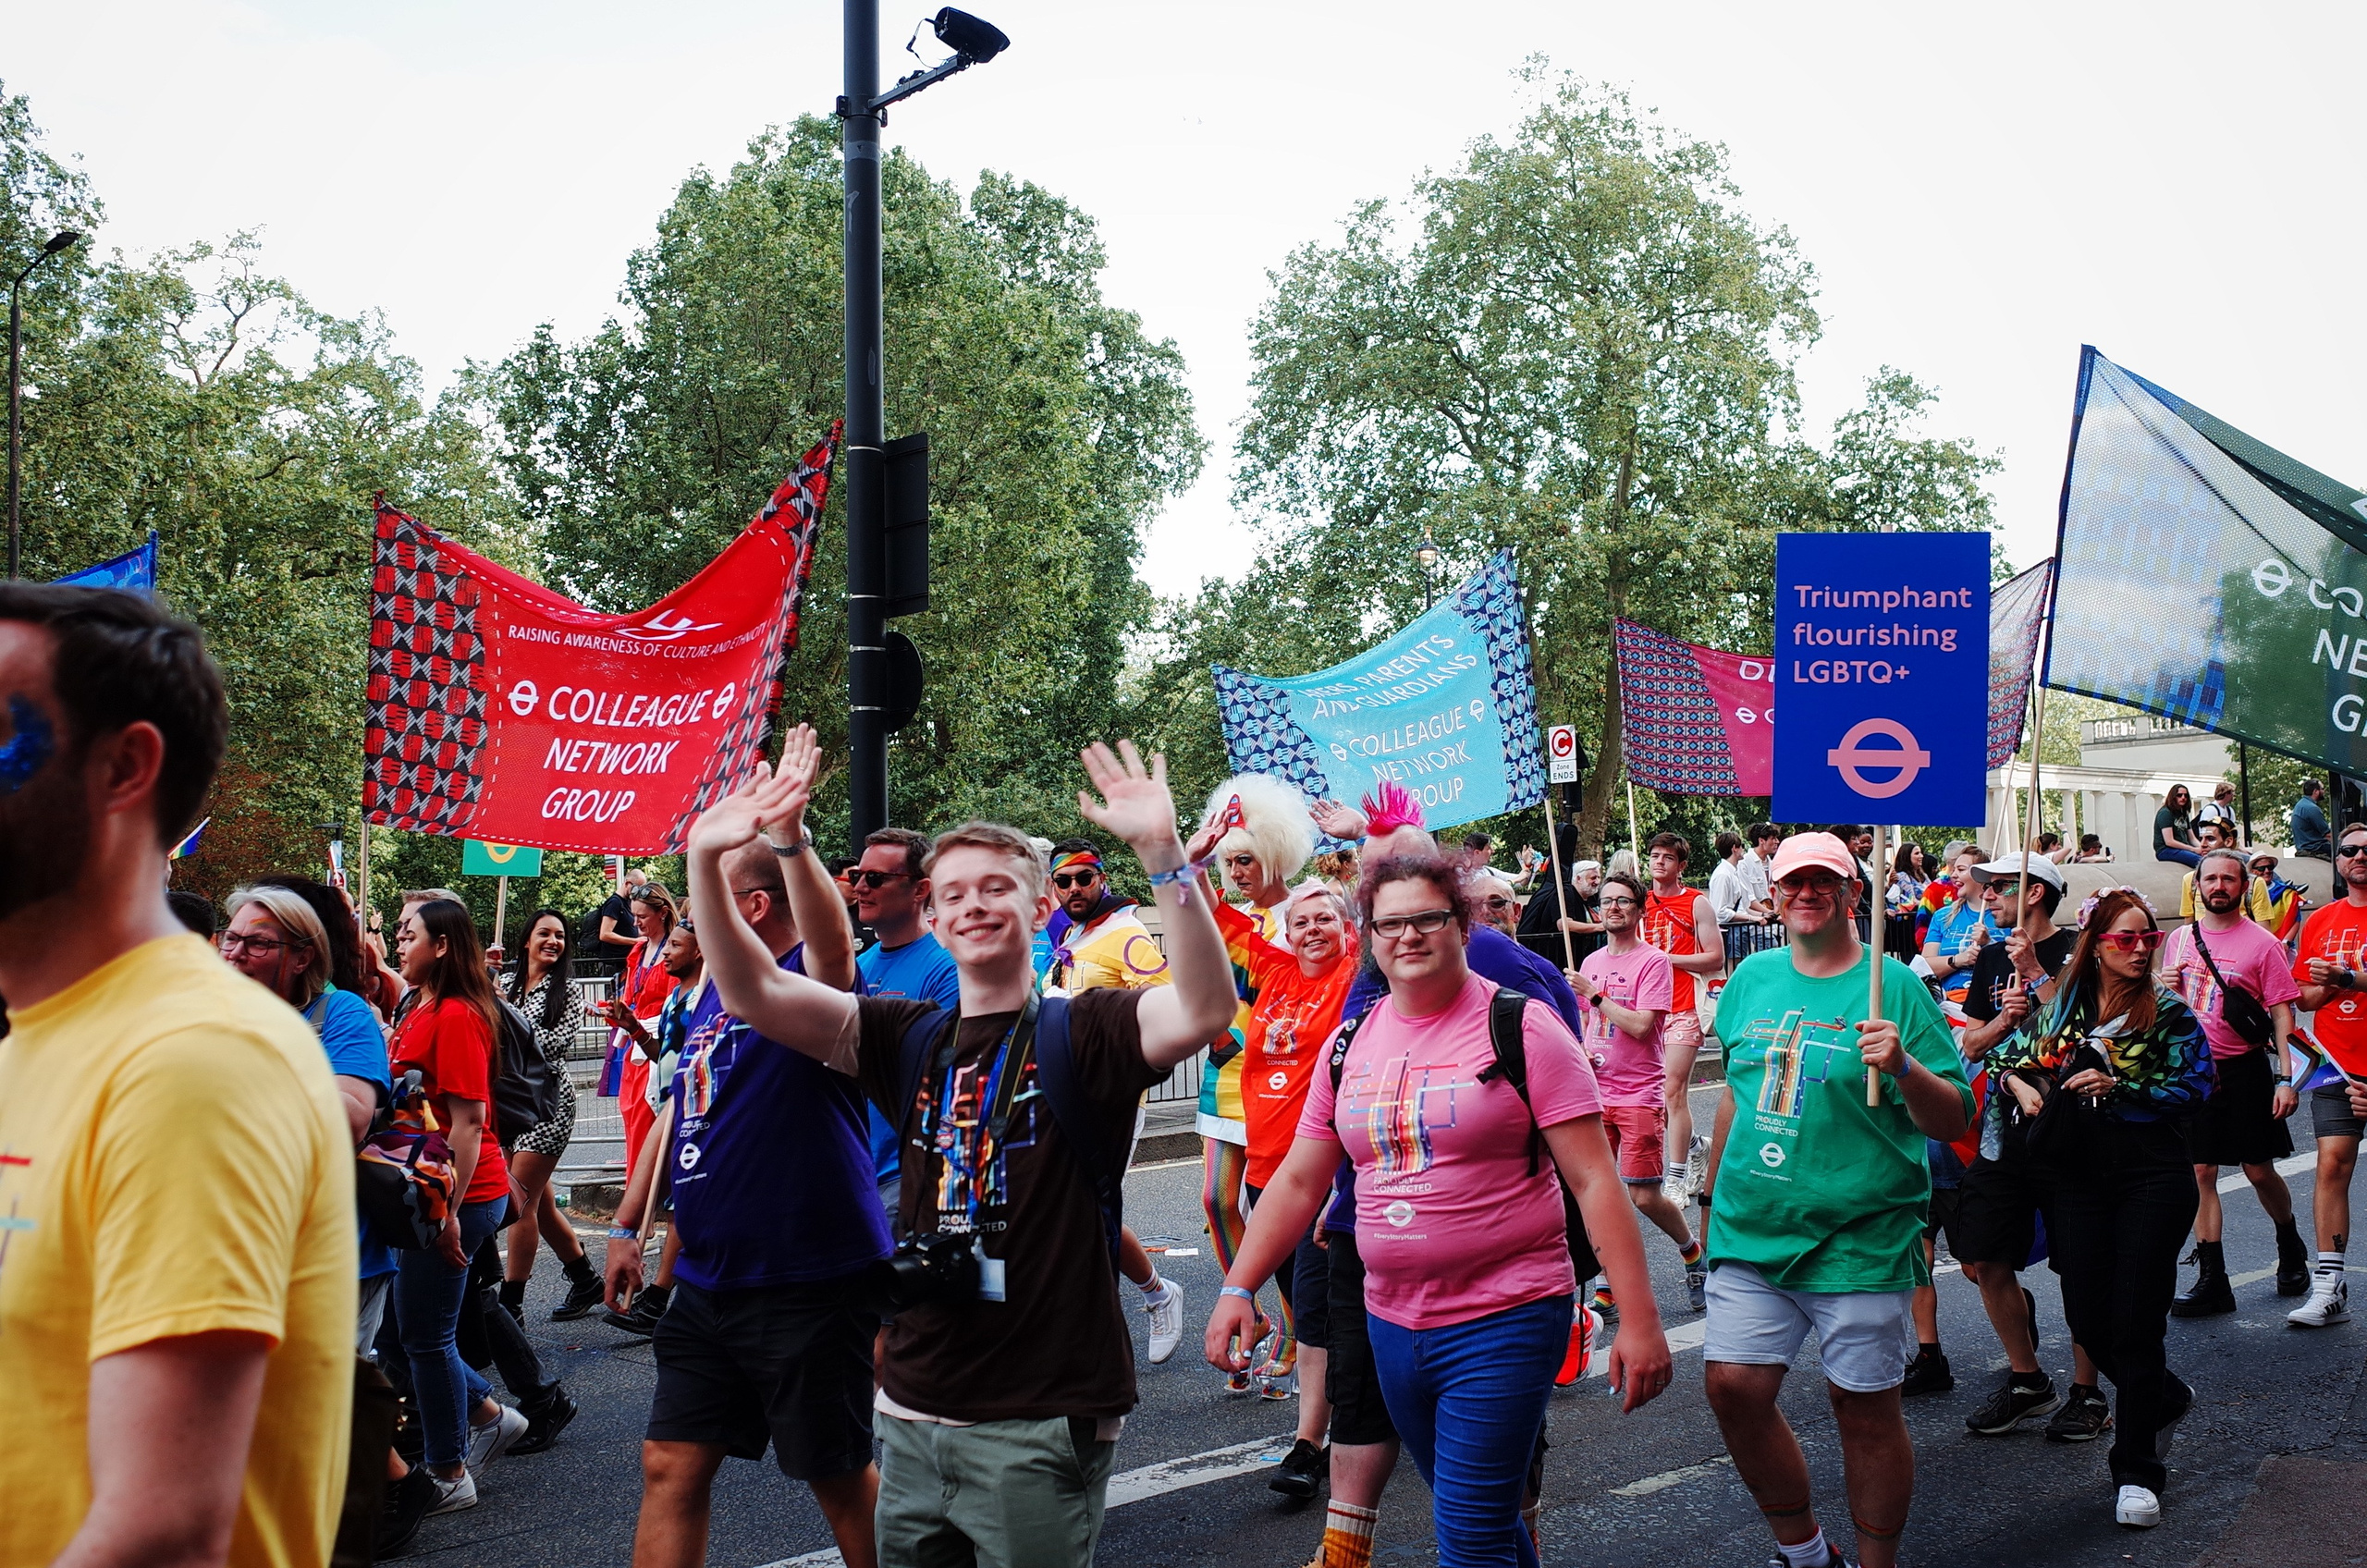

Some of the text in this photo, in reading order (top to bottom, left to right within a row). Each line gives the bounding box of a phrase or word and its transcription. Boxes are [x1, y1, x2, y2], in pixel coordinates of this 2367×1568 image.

[1793, 584, 1972, 614] Triumphant
[508, 624, 561, 645] RAISING
[563, 632, 640, 655] AWARENESS
[643, 643, 663, 657] OF
[663, 644, 713, 659] CULTURE
[711, 639, 732, 655] AND
[1792, 621, 1958, 652] flourishing
[1354, 633, 1455, 688] PARENTS
[1793, 660, 1911, 685] LGBTQ+
[1355, 653, 1478, 707] GUARDIANS
[548, 686, 713, 729] COLLEAGUE
[2332, 693, 2367, 739] G
[1348, 705, 1467, 758] COLLEAGUE
[543, 738, 680, 777] NETWORK
[1371, 740, 1473, 782] NETWORK
[1553, 770, 1575, 780] ENDS
[541, 786, 636, 825] GROUP
[1410, 776, 1464, 810] ROUP
[1754, 1122, 1798, 1137] CONNECTED
[1755, 1114, 1787, 1127] PROUDLY
[1373, 1176, 1415, 1184] PROUDLY
[1373, 1183, 1432, 1193] CONNECTED
[938, 1214, 972, 1225] PROU
